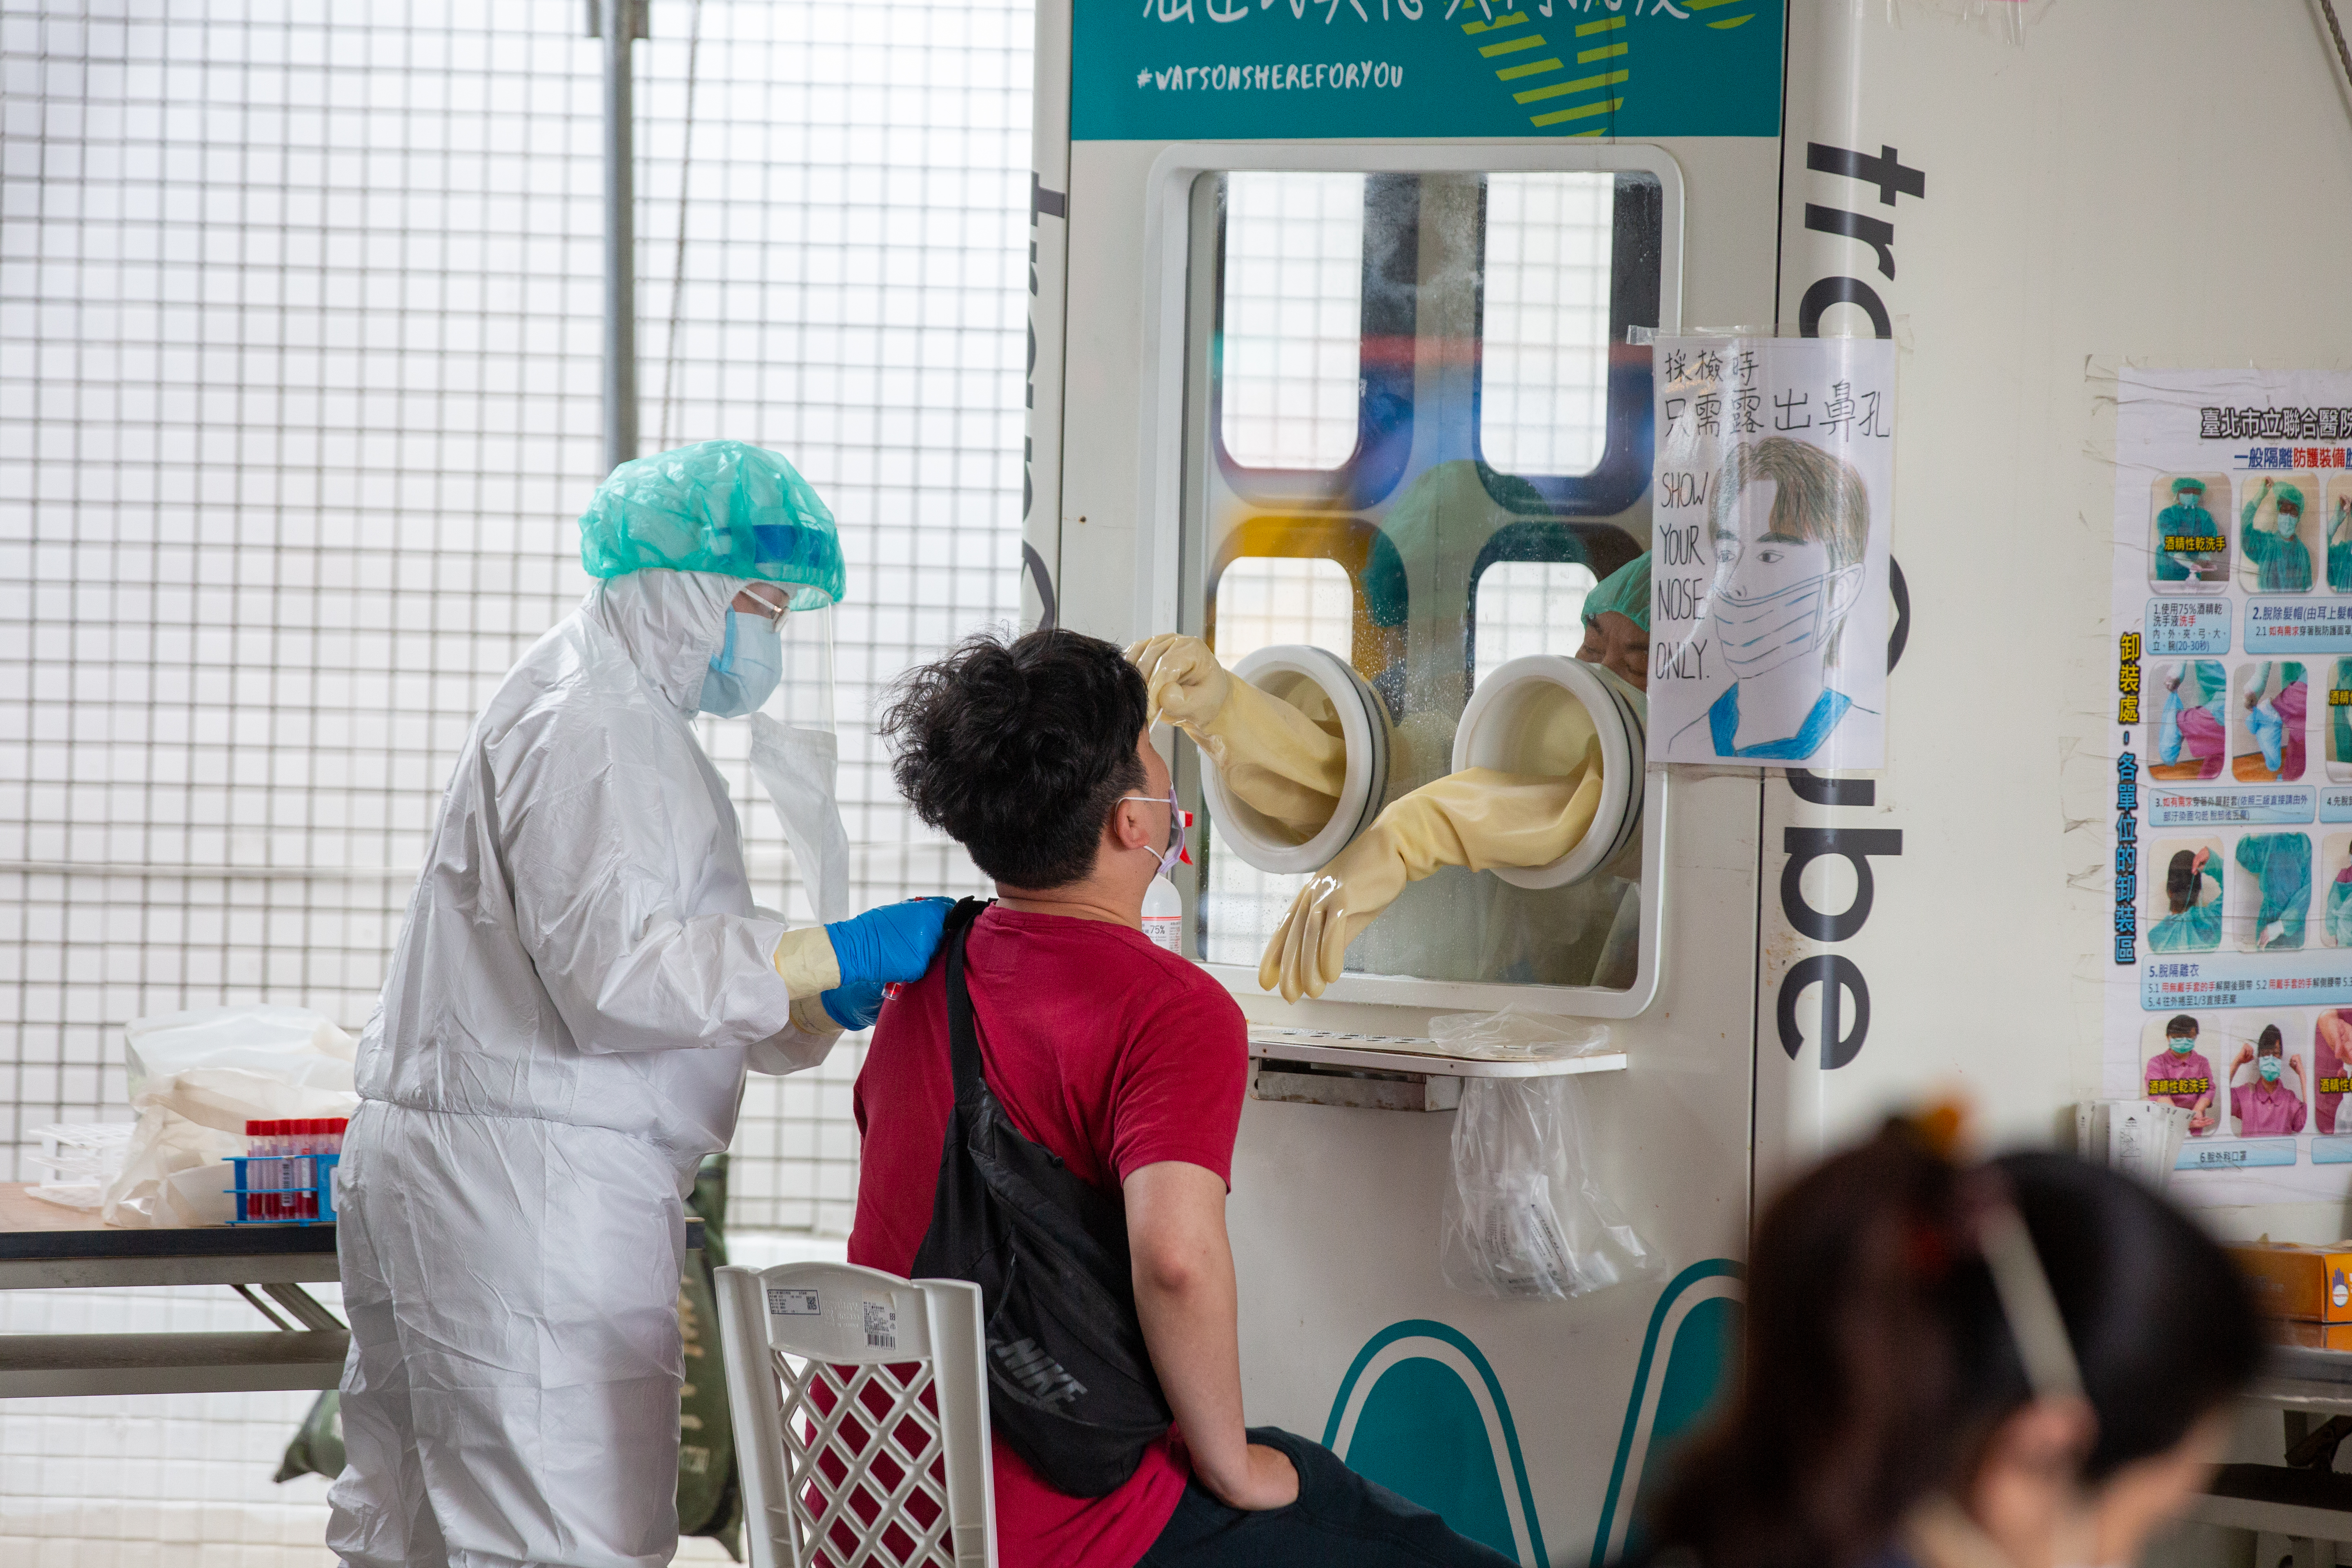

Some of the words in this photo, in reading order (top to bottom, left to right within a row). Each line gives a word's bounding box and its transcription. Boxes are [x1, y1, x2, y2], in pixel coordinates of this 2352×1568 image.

[1137, 60, 1403, 90] #WATSONSHEREFORYOU
[1665, 349, 1759, 386] 採檢時
[1665, 378, 1890, 442] 只需露出鼻孔
[1661, 472, 1708, 509] SHOW
[1659, 523, 1705, 566] YOUR
[2164, 536, 2225, 552] 酒精性乾洗手
[1658, 578, 1705, 621] NOSE
[1656, 639, 1710, 680] ONLY.
[2329, 690, 2352, 706] 酒精
[1150, 925, 1165, 934] 75%
[2149, 963, 2200, 978] 5.脫隔離衣
[996, 1336, 1088, 1403] NIKE
